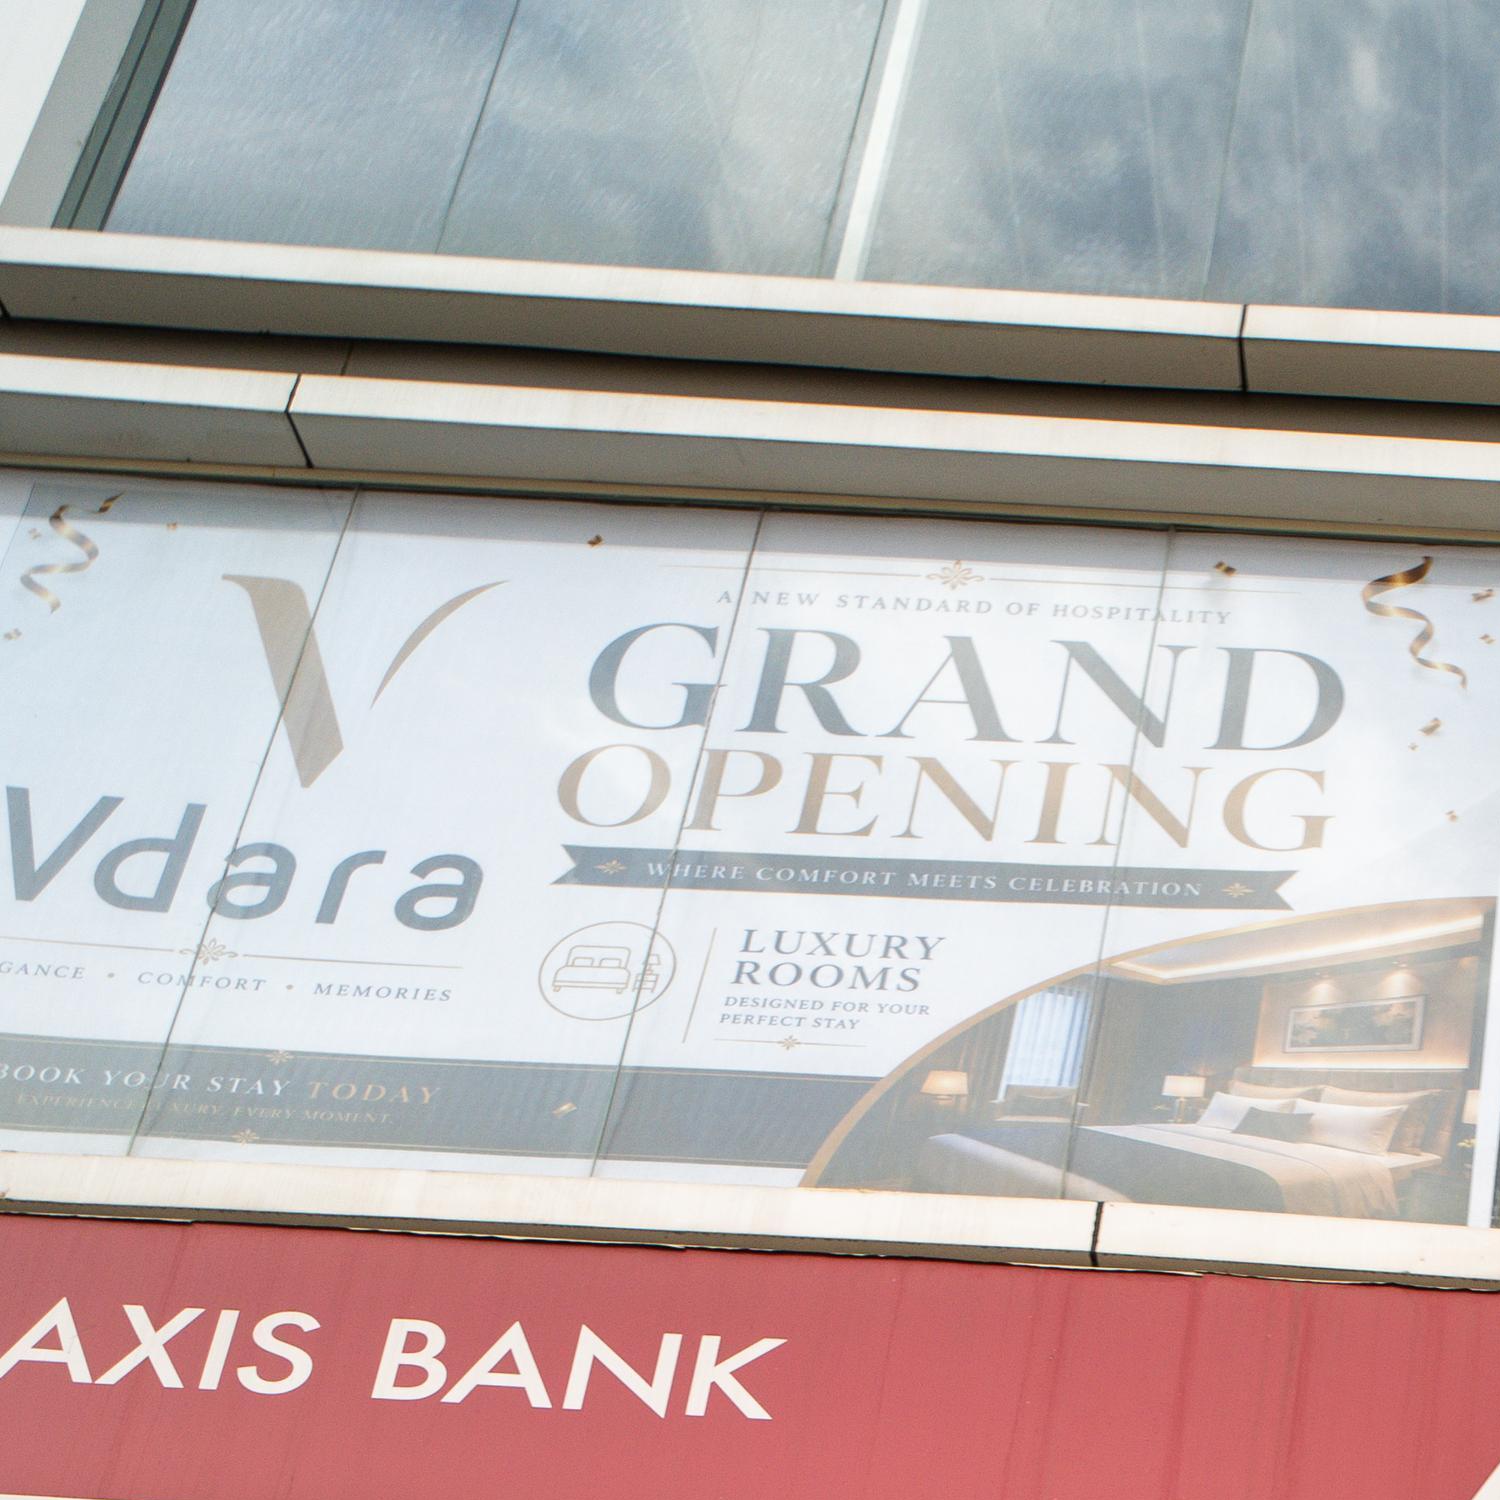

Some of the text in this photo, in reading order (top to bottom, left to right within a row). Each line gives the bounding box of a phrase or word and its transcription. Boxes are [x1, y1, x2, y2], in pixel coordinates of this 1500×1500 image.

[717, 590, 1232, 626] A NEW STANDARD OF HOSPITALITY
[588, 621, 1347, 752] GRAND
[557, 743, 1335, 852] OPENING
[4, 786, 484, 932] Vdara
[647, 861, 1203, 898] WHERE COMFORT MEETS CELEBRATION
[739, 928, 947, 963] LUXURY
[137, 971, 268, 992] COMFORT
[313, 981, 453, 1002] MEMORIES
[732, 959, 922, 992] ROOMS
[719, 1013, 860, 1031] PERFECT STAY
[723, 997, 931, 1016] DESIGNED FOR YOUR
[206, 1075, 293, 1099] STAY
[307, 1080, 442, 1105] TODAY
[0, 1297, 788, 1420] AXIS BANK
